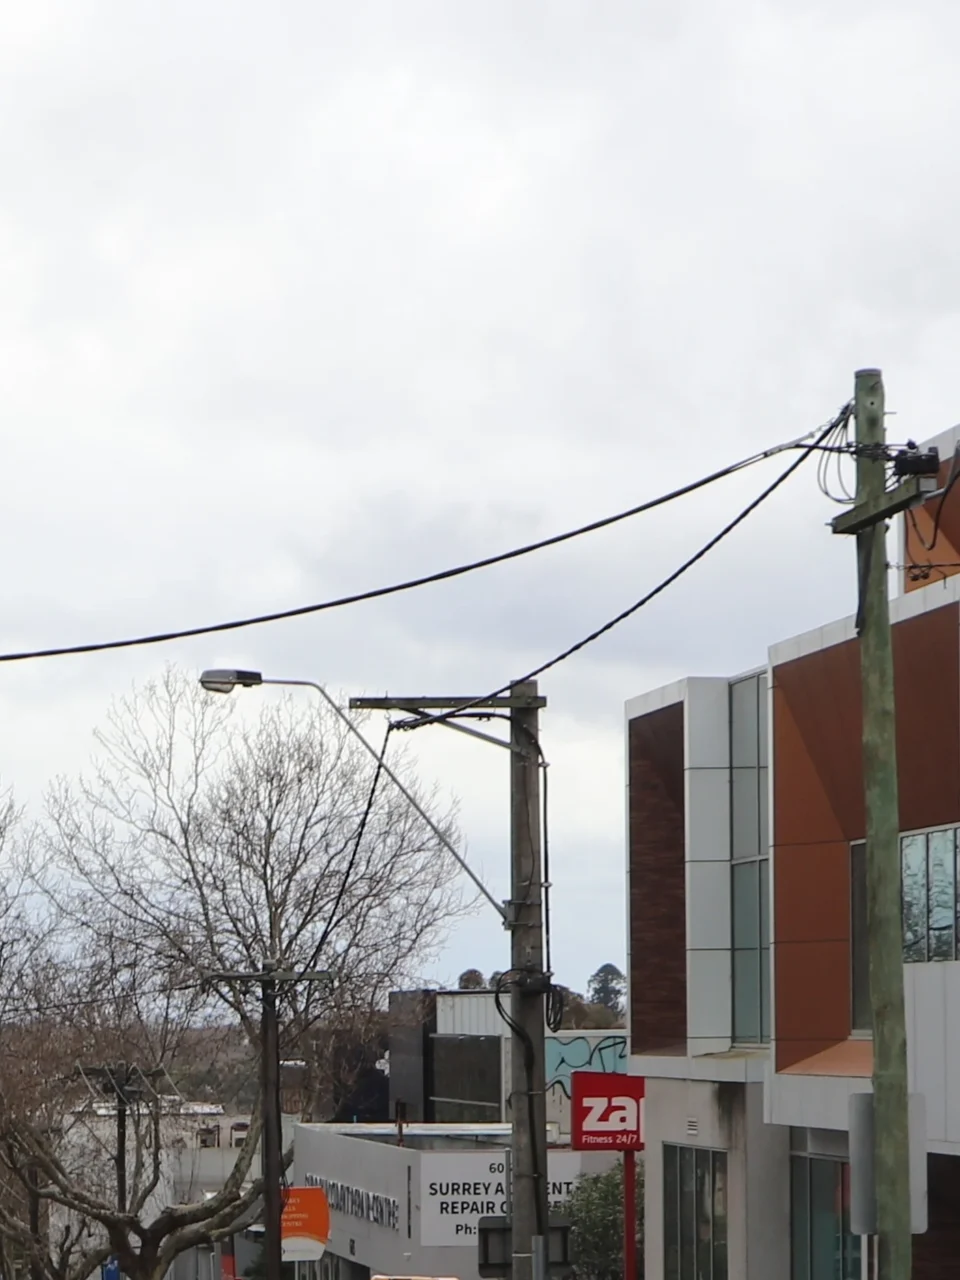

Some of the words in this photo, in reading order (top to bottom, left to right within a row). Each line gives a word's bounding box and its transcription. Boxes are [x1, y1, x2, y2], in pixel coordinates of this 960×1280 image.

[582, 1096, 644, 1143] za
[582, 1135, 613, 1144] Fitness
[616, 1134, 637, 1144] 24/7
[429, 1183, 491, 1196] SURREY
[440, 1201, 496, 1214] REPAIR
[455, 1223, 477, 1235] Ph:
